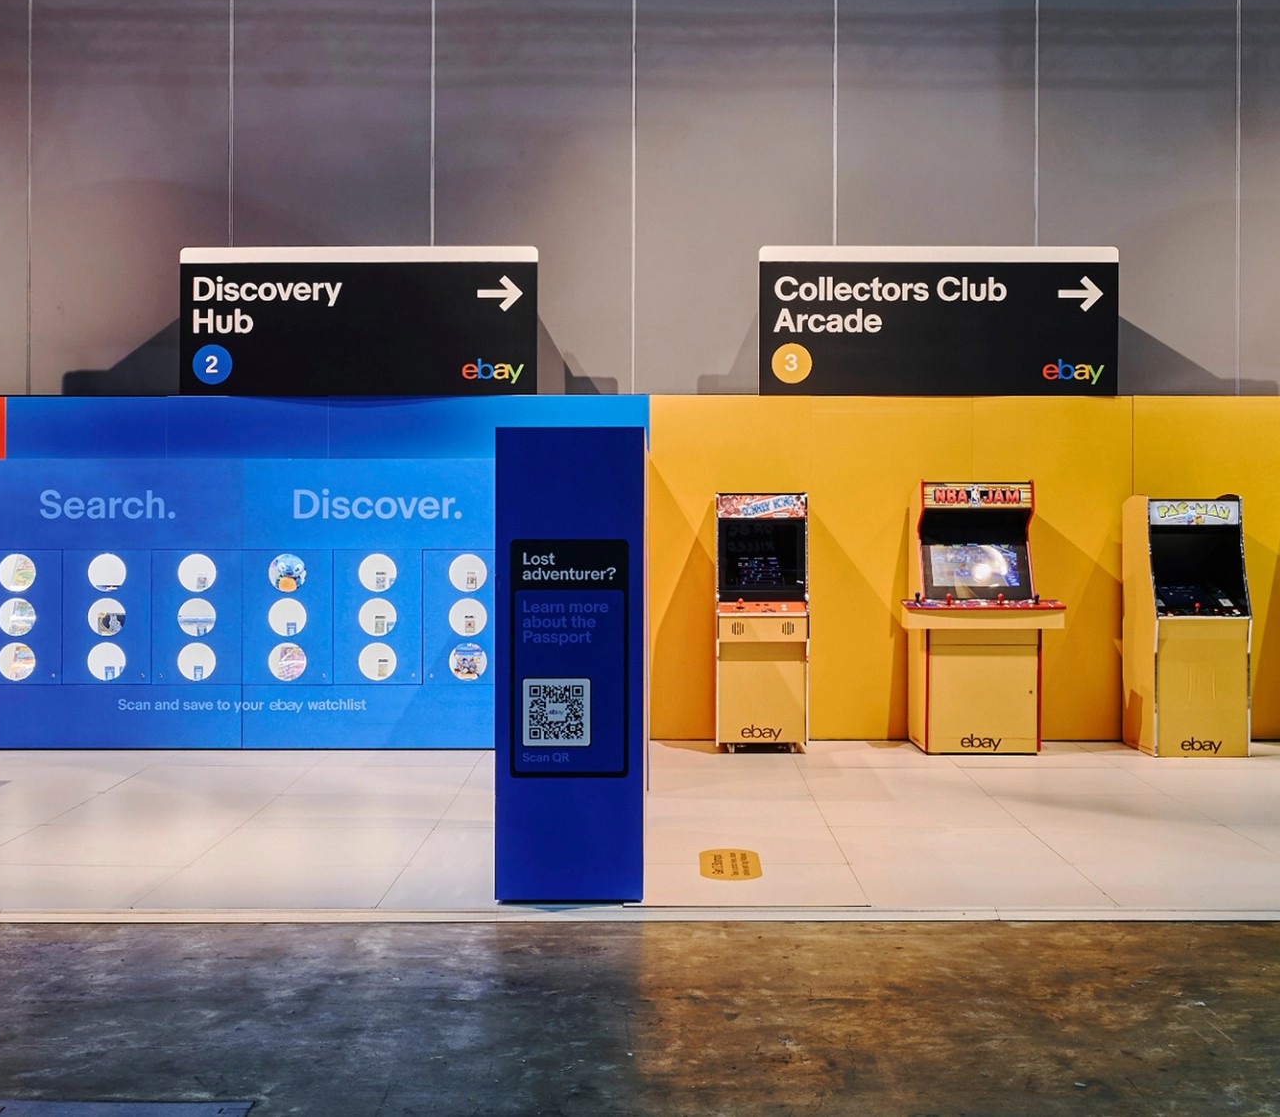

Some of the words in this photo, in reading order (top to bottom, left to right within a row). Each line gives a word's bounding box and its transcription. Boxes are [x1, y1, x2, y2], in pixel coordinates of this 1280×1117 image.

[192, 276, 342, 307] Discovery
[774, 276, 929, 302] Collectors
[937, 276, 1007, 302] Club
[192, 308, 254, 334] Hub
[773, 308, 883, 333] Arcade
[205, 355, 219, 373] 2
[462, 358, 524, 384] ebay
[784, 353, 798, 371] 3
[1042, 358, 1104, 384] ebay
[39, 488, 176, 521] Search.
[293, 488, 462, 521] Discover.
[934, 488, 968, 503] NBA
[983, 488, 1021, 503] JAM
[522, 552, 555, 565] Lost
[522, 567, 617, 581] adventurer?
[523, 600, 565, 613] Learn
[569, 602, 609, 613] more
[523, 616, 568, 628] about
[571, 616, 596, 628] the
[523, 631, 592, 646] Passport
[118, 698, 150, 711] Scan
[154, 698, 179, 711] and
[183, 701, 213, 711] save
[217, 699, 230, 711] to
[234, 700, 264, 714] your
[269, 698, 302, 714] ebay
[308, 698, 367, 711] watchlist
[741, 724, 782, 742] ebay
[960, 733, 1002, 752] ebay
[1180, 736, 1223, 755] ebay
[523, 752, 550, 763] Scan
[553, 752, 570, 763] QR
